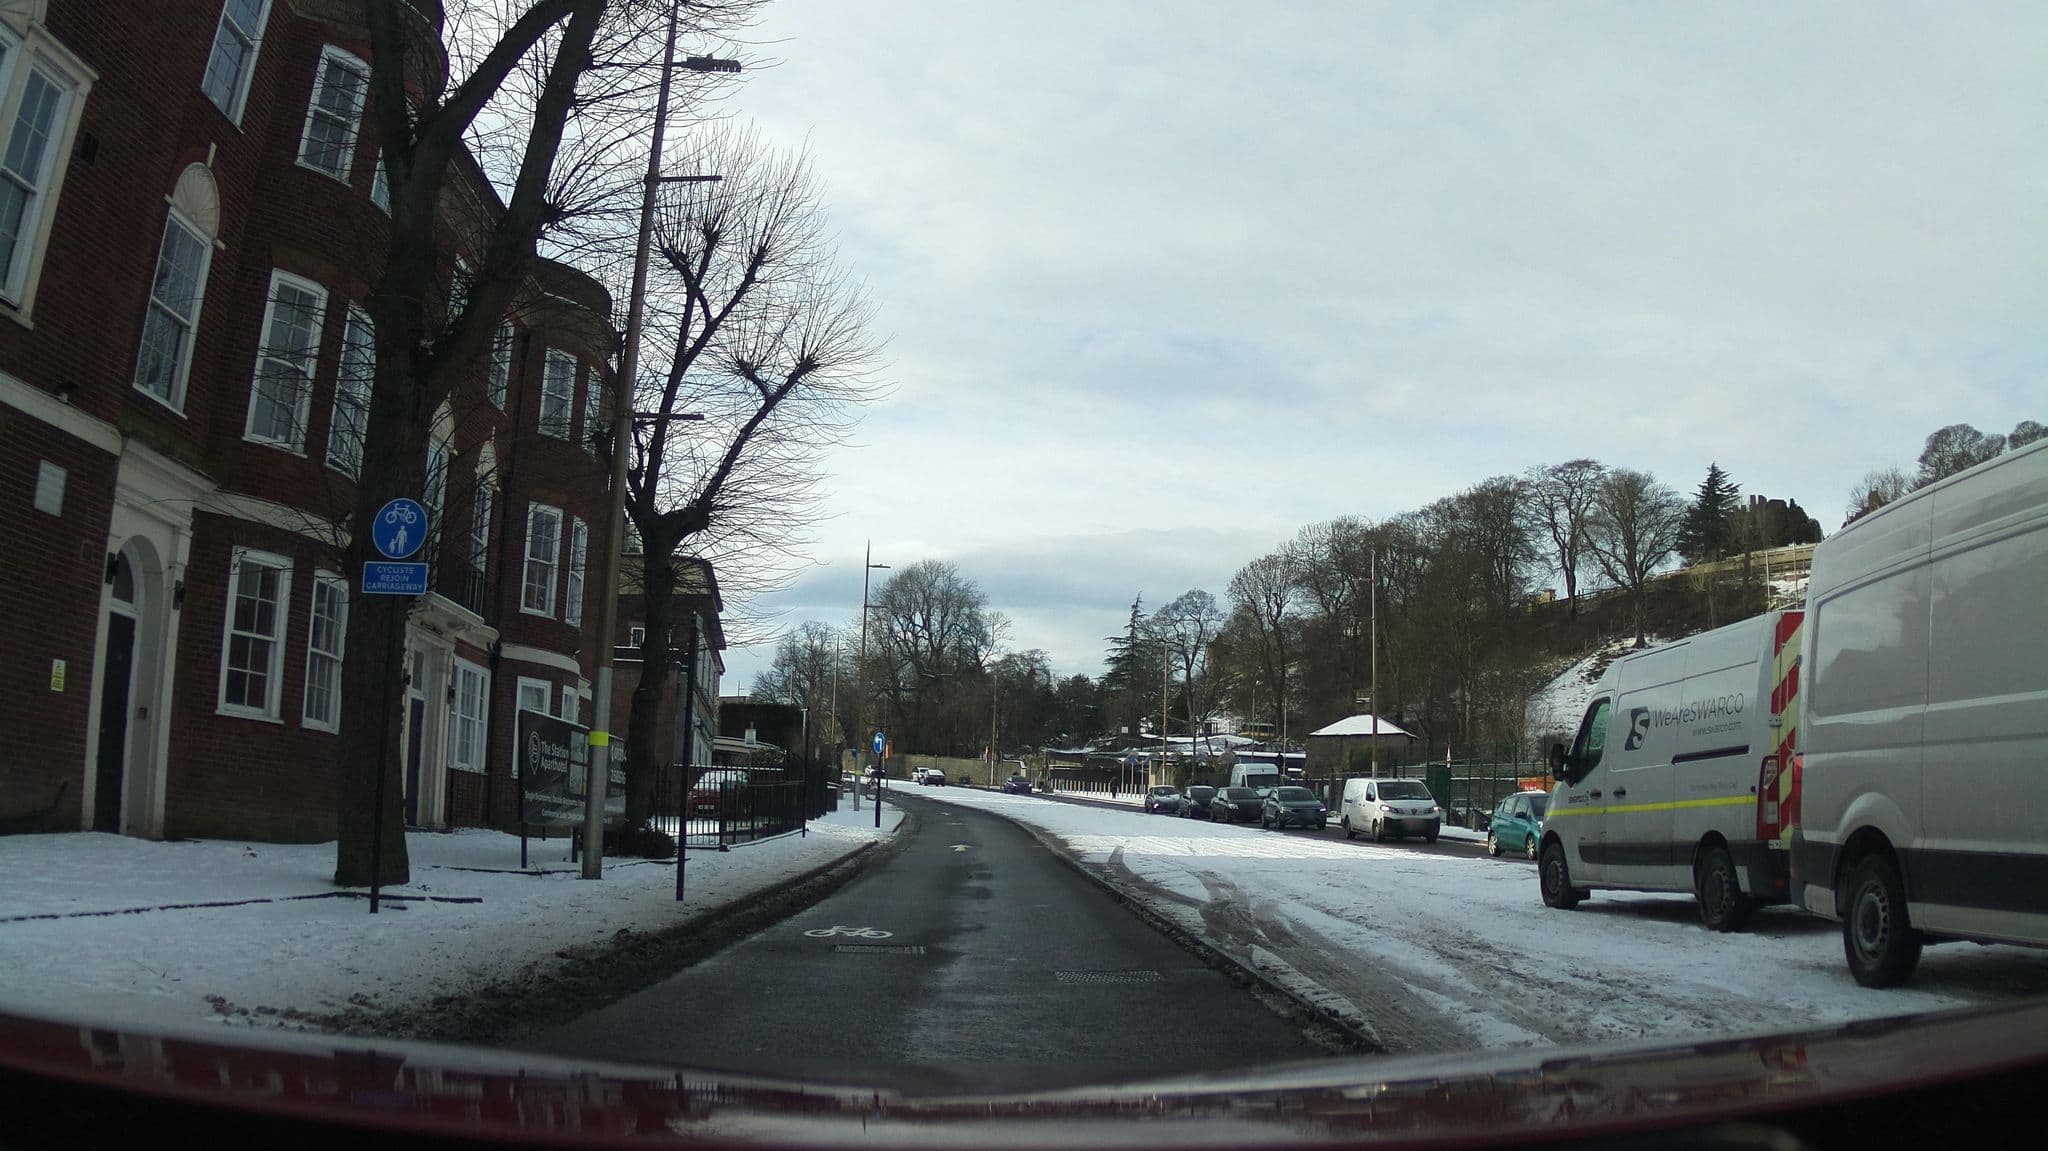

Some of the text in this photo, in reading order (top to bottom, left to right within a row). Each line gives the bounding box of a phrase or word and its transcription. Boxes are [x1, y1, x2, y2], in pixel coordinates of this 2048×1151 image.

[376, 566, 415, 574] CYCLISTS
[366, 582, 423, 591] CARRIAGEWAY
[1654, 693, 1745, 728] WeAreSWARCO
[541, 741, 569, 758] The Station
[541, 757, 568, 773] Aparthotel
